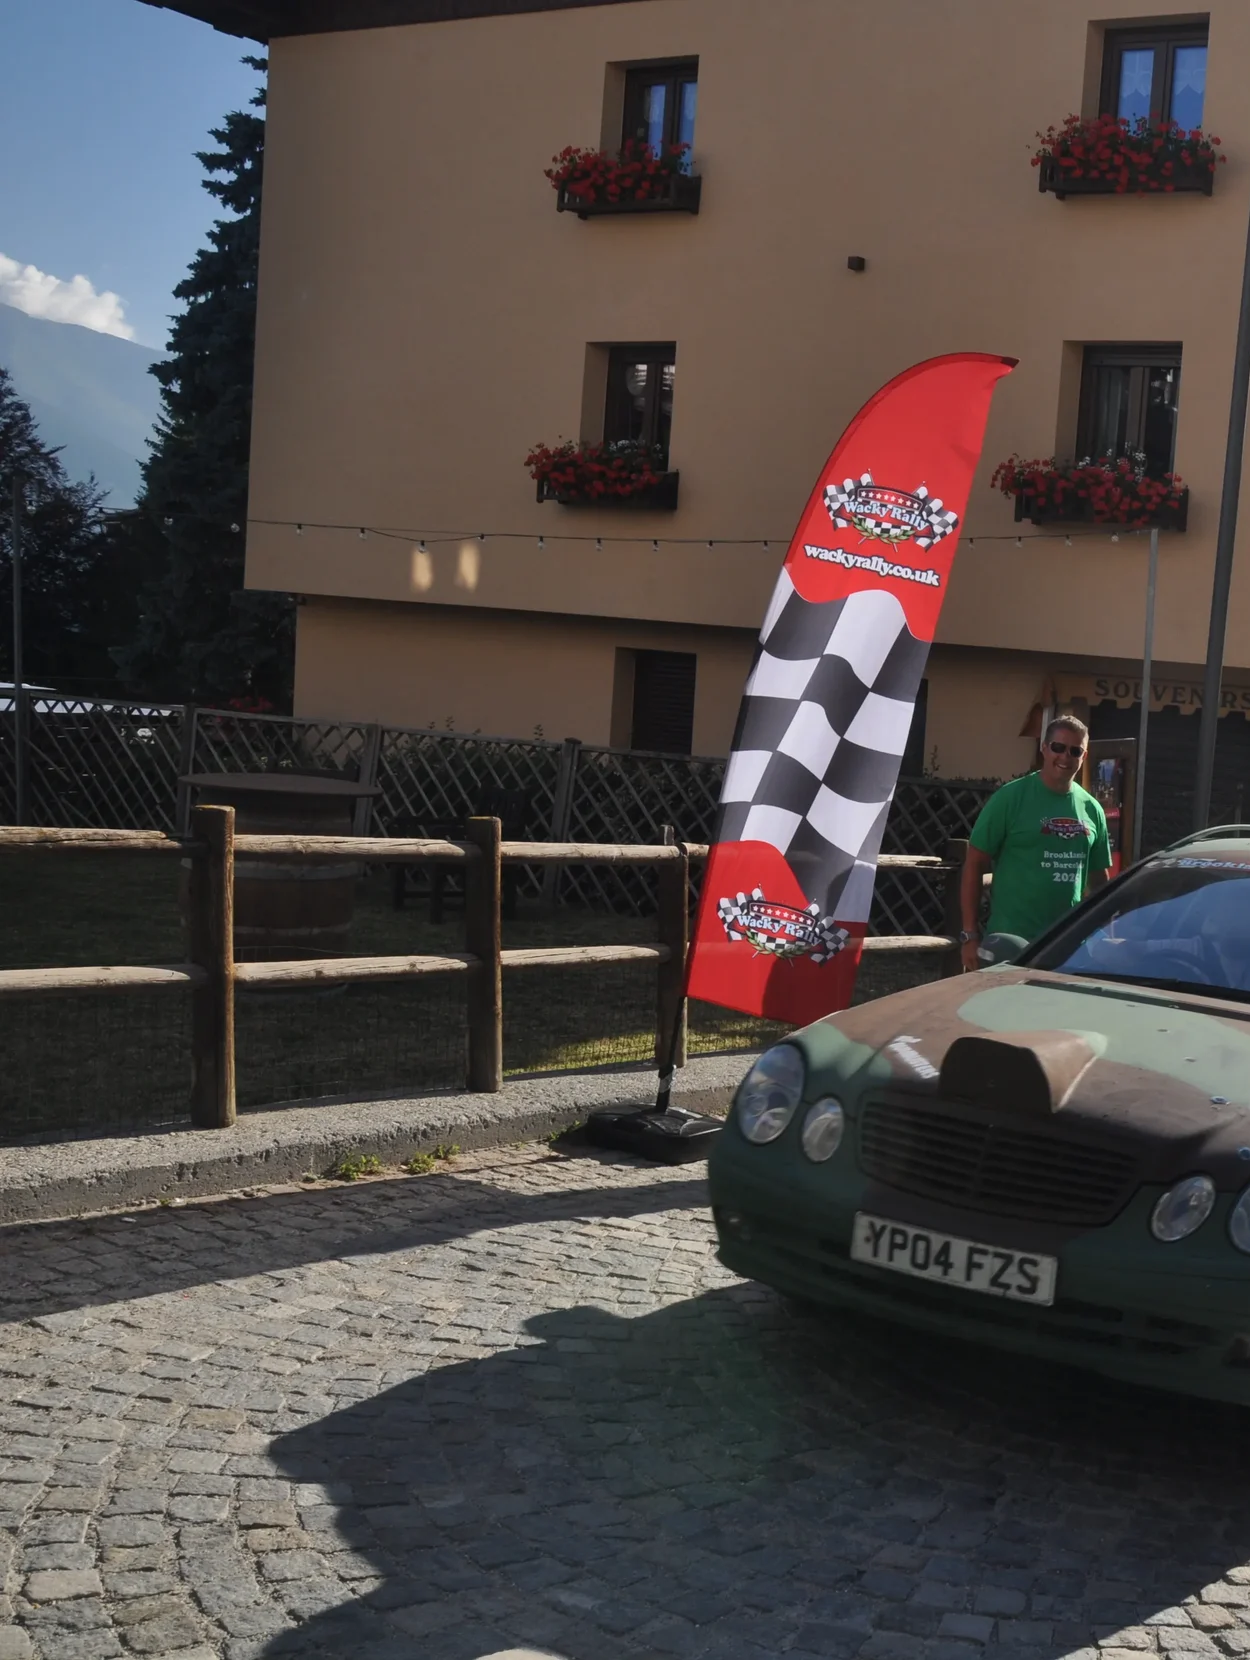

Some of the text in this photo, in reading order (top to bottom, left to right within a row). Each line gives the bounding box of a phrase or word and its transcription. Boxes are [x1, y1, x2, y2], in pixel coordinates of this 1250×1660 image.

[844, 499, 929, 531] Wacky Rally
[804, 544, 940, 587] wackyrally.co.uk
[737, 915, 822, 946] Wacky Rally
[867, 1220, 1040, 1296] YP04 FZS
